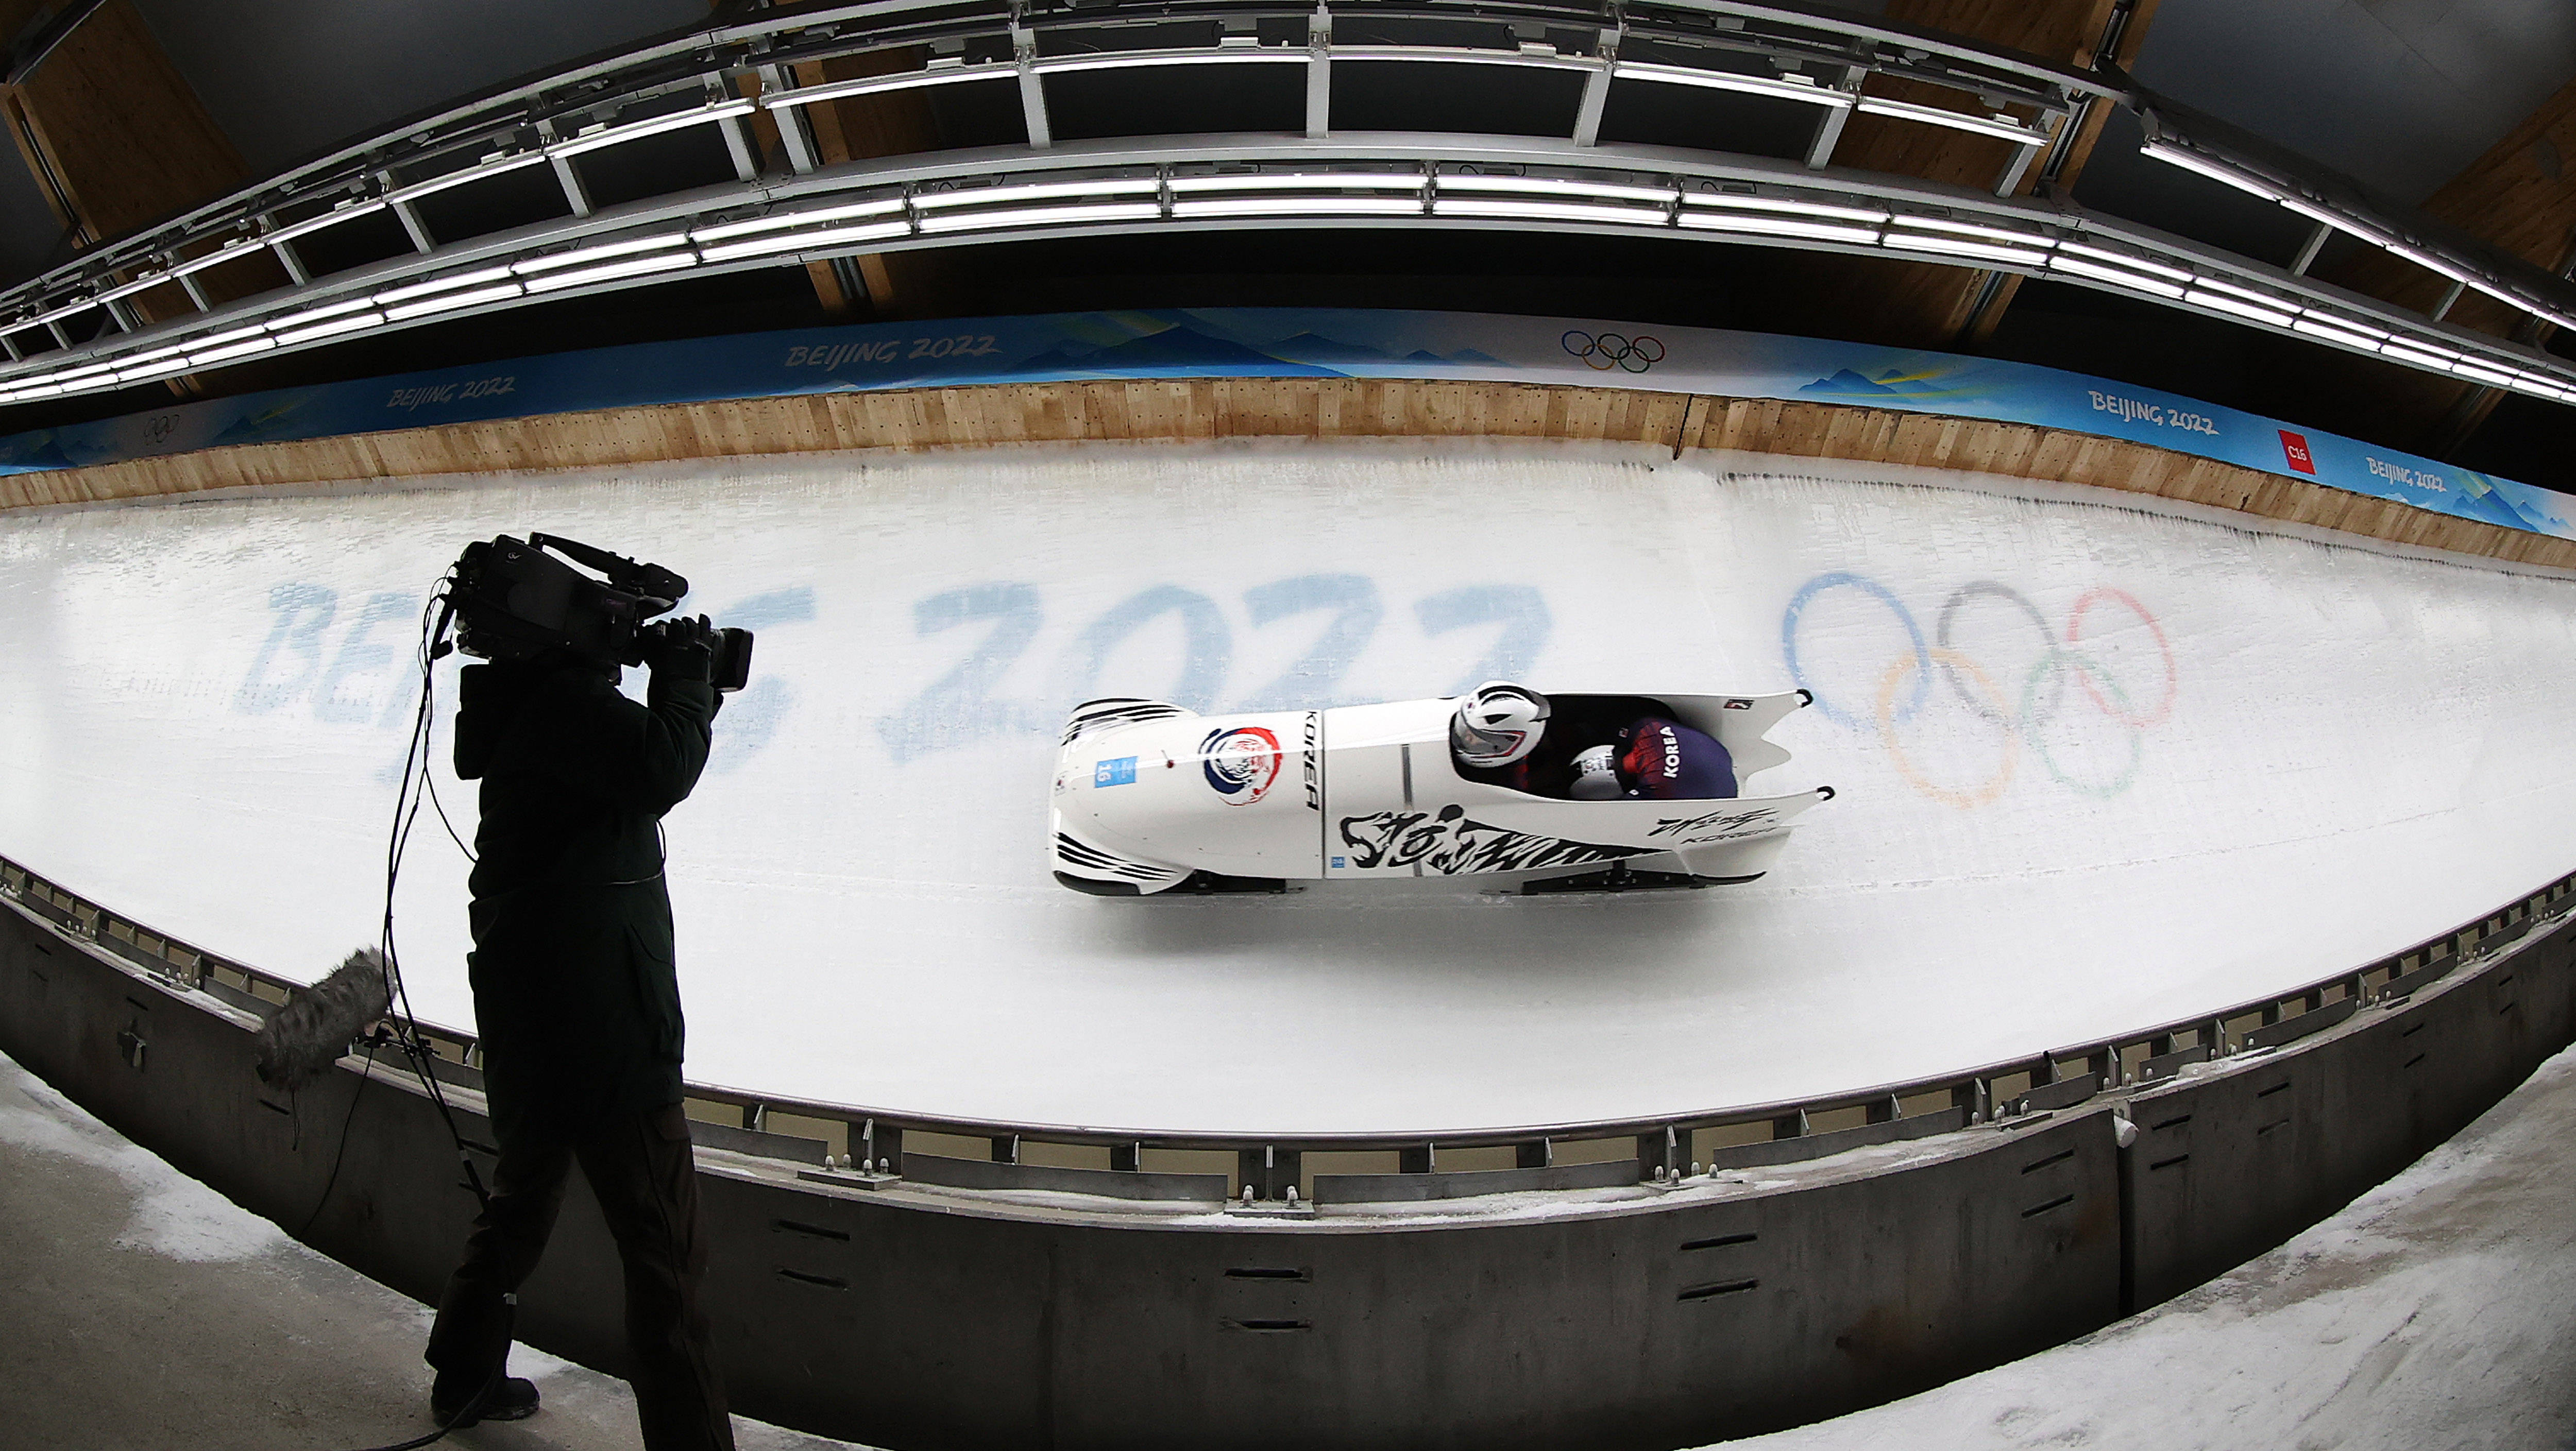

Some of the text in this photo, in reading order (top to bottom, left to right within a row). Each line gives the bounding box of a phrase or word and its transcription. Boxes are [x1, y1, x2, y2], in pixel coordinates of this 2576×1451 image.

[785, 335, 1003, 371] BEIJING 2022
[386, 376, 515, 412] BEIJING 2022
[2088, 390, 2219, 435] BEIJING 2022
[2288, 445, 2307, 461] C16
[2366, 456, 2447, 492] BEIJING 2022
[1304, 711, 1320, 811] KOREA
[1659, 725, 1680, 778] KOREA
[1097, 764, 1112, 782] 16
